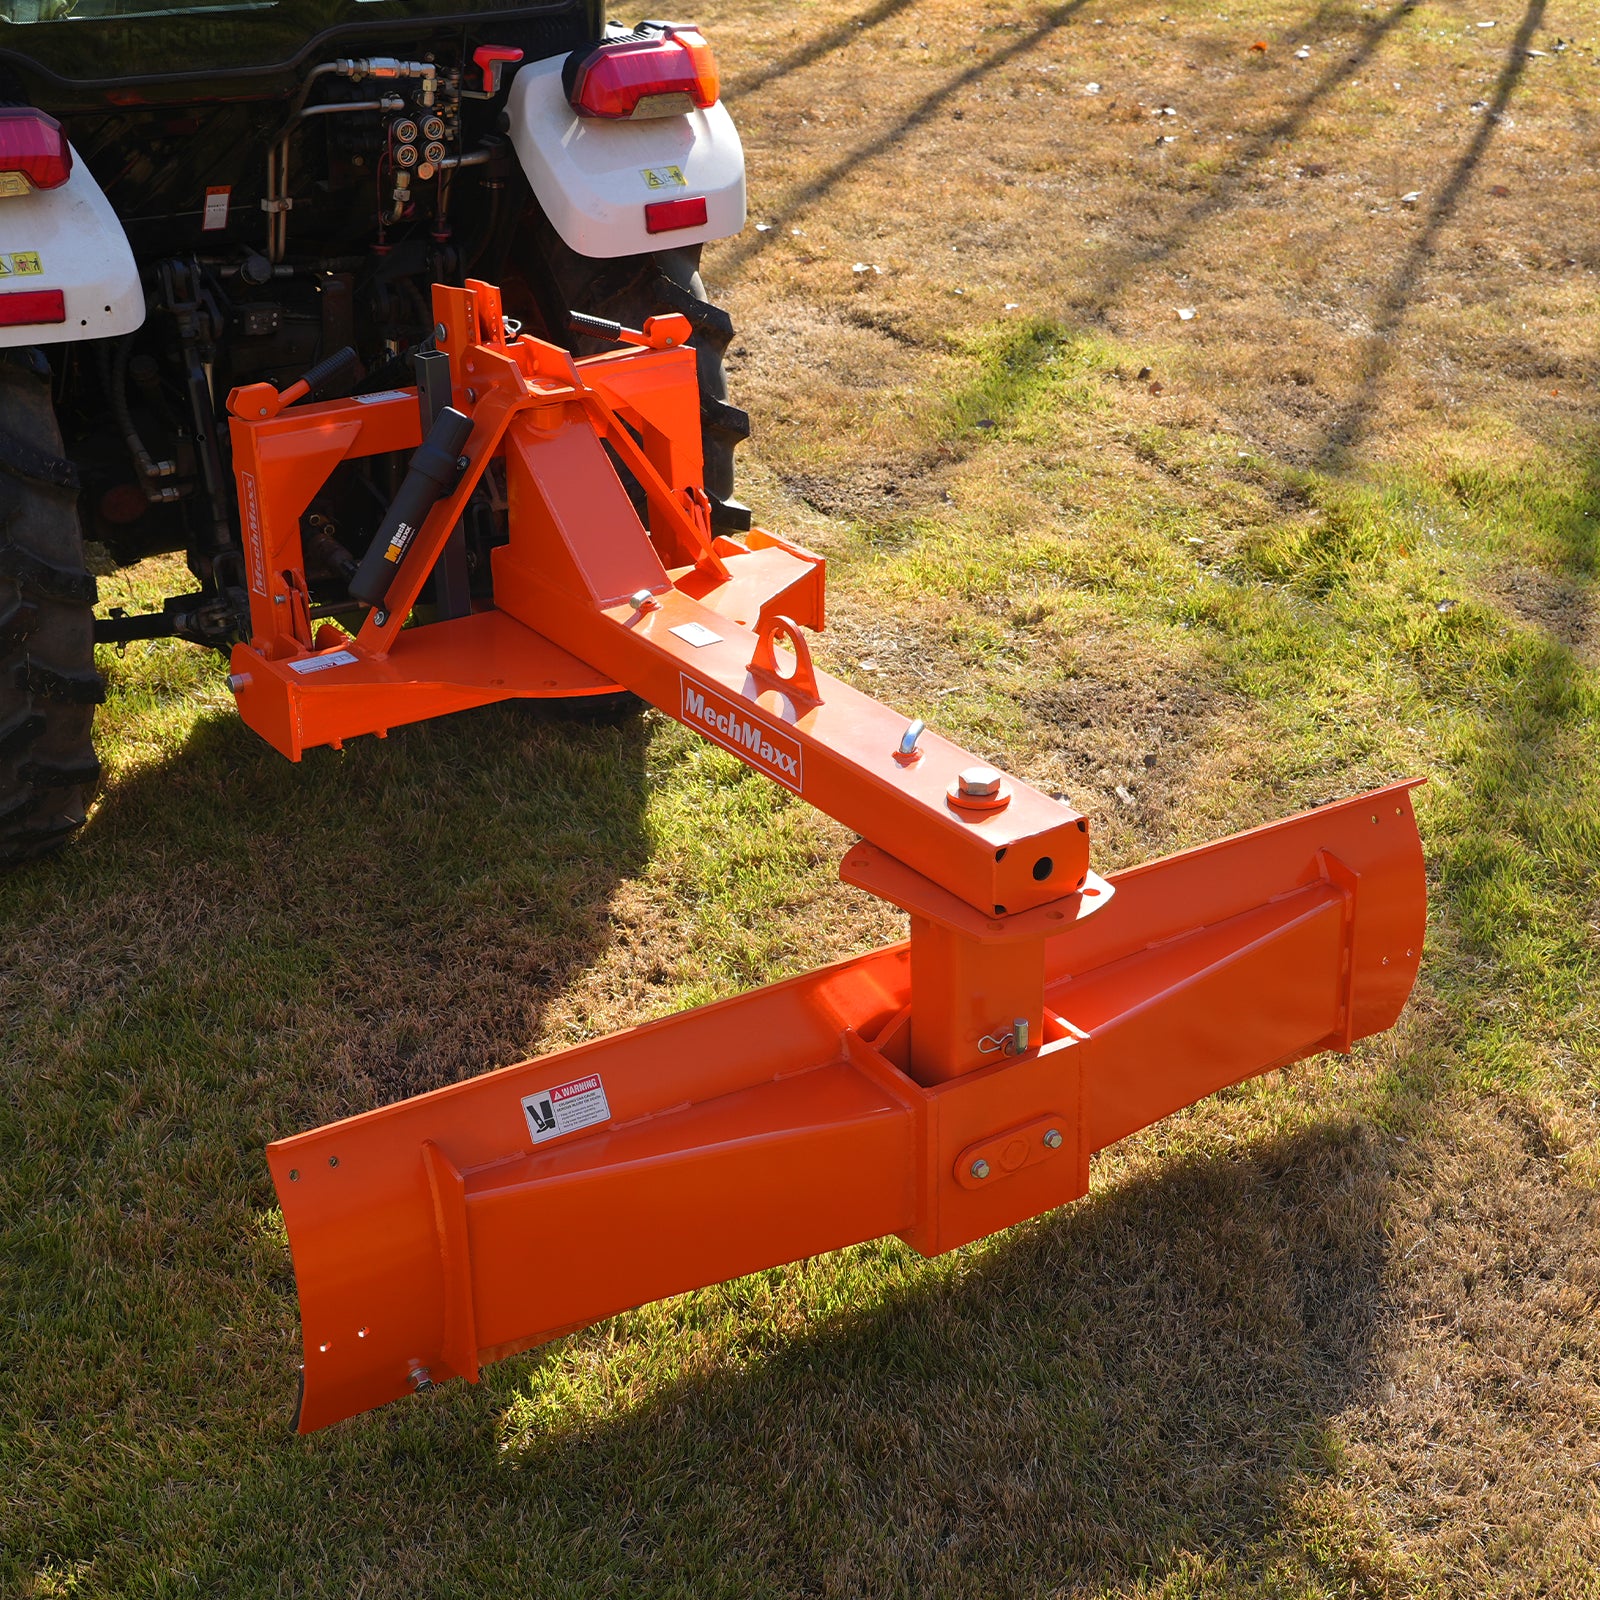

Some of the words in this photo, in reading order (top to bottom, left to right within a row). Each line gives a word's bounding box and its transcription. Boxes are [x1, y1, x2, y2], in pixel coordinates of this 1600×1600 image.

[247, 478, 264, 591] MechMaxx
[685, 687, 799, 778] MechMaxx
[561, 1078, 597, 1097] WARNING
